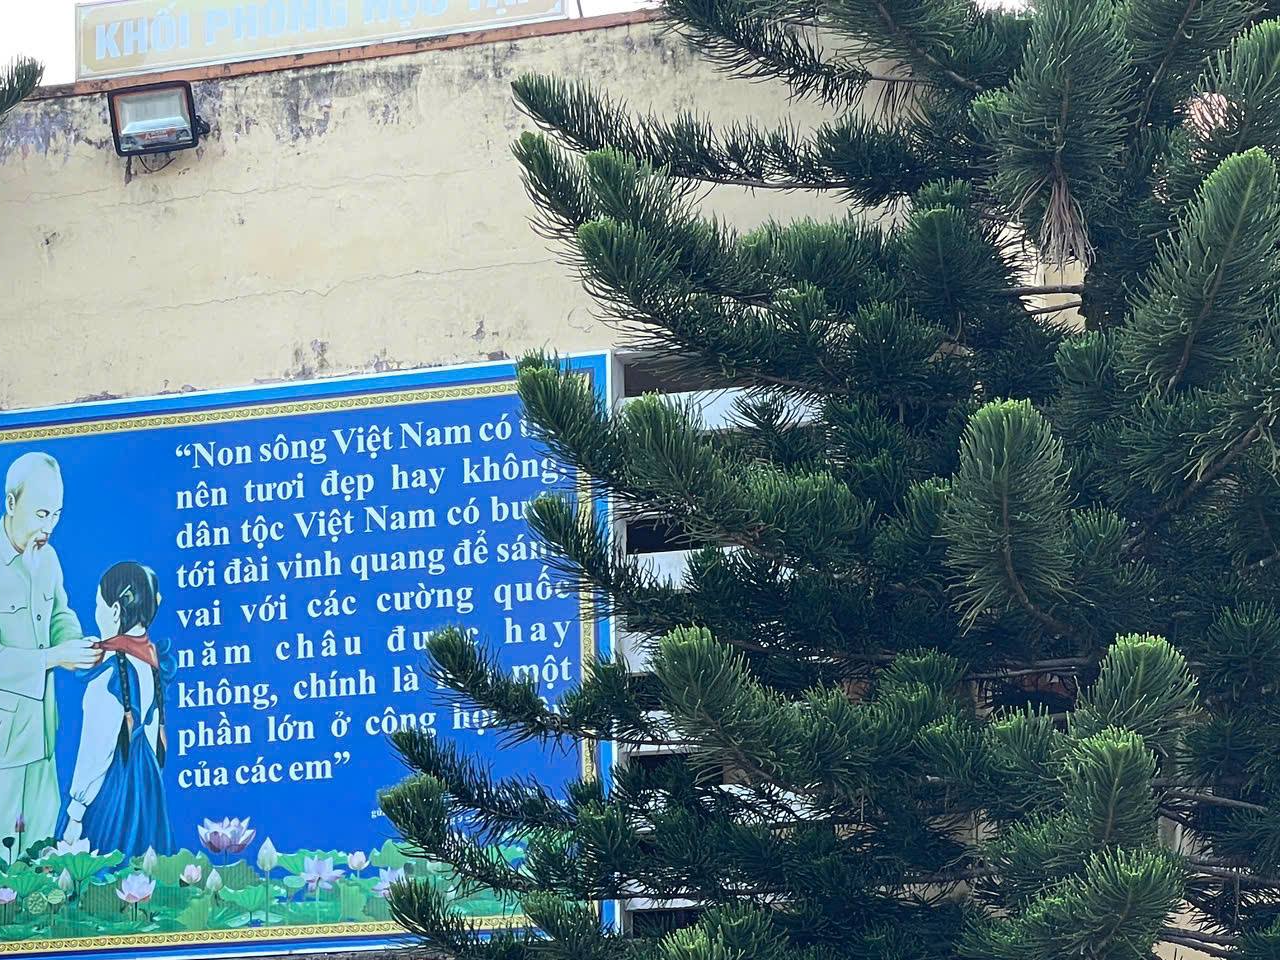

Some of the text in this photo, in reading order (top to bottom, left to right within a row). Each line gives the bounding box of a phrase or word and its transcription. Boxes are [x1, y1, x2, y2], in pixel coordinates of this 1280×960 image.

[260, 433, 327, 465] sông
[332, 426, 394, 460] Việt
[400, 422, 472, 450] Nam
[480, 413, 513, 442] có
[176, 481, 228, 510] nên
[244, 472, 305, 503] tươi
[321, 470, 375, 502] đẹp
[392, 464, 447, 495] hay
[176, 521, 230, 549] dân
[241, 516, 284, 545] tộc
[293, 509, 355, 543] Việt
[364, 505, 437, 533] Nam
[447, 498, 480, 526] có
[176, 558, 216, 590] tới
[224, 553, 269, 586] đài
[276, 550, 343, 580] vinh
[350, 548, 446, 582] quang
[453, 529, 489, 565] để
[177, 600, 221, 629] vai
[240, 593, 288, 624] với
[307, 588, 357, 618] các
[376, 581, 474, 614] cường
[178, 641, 251, 669] năm
[275, 630, 363, 661] châu
[504, 617, 572, 648] hay
[178, 678, 278, 710] không,
[293, 669, 377, 700] chính
[392, 665, 419, 693] là
[178, 712, 252, 756] phần
[267, 711, 314, 742] lớn
[331, 710, 352, 738] ở
[178, 760, 229, 789] của
[235, 753, 283, 785] các
